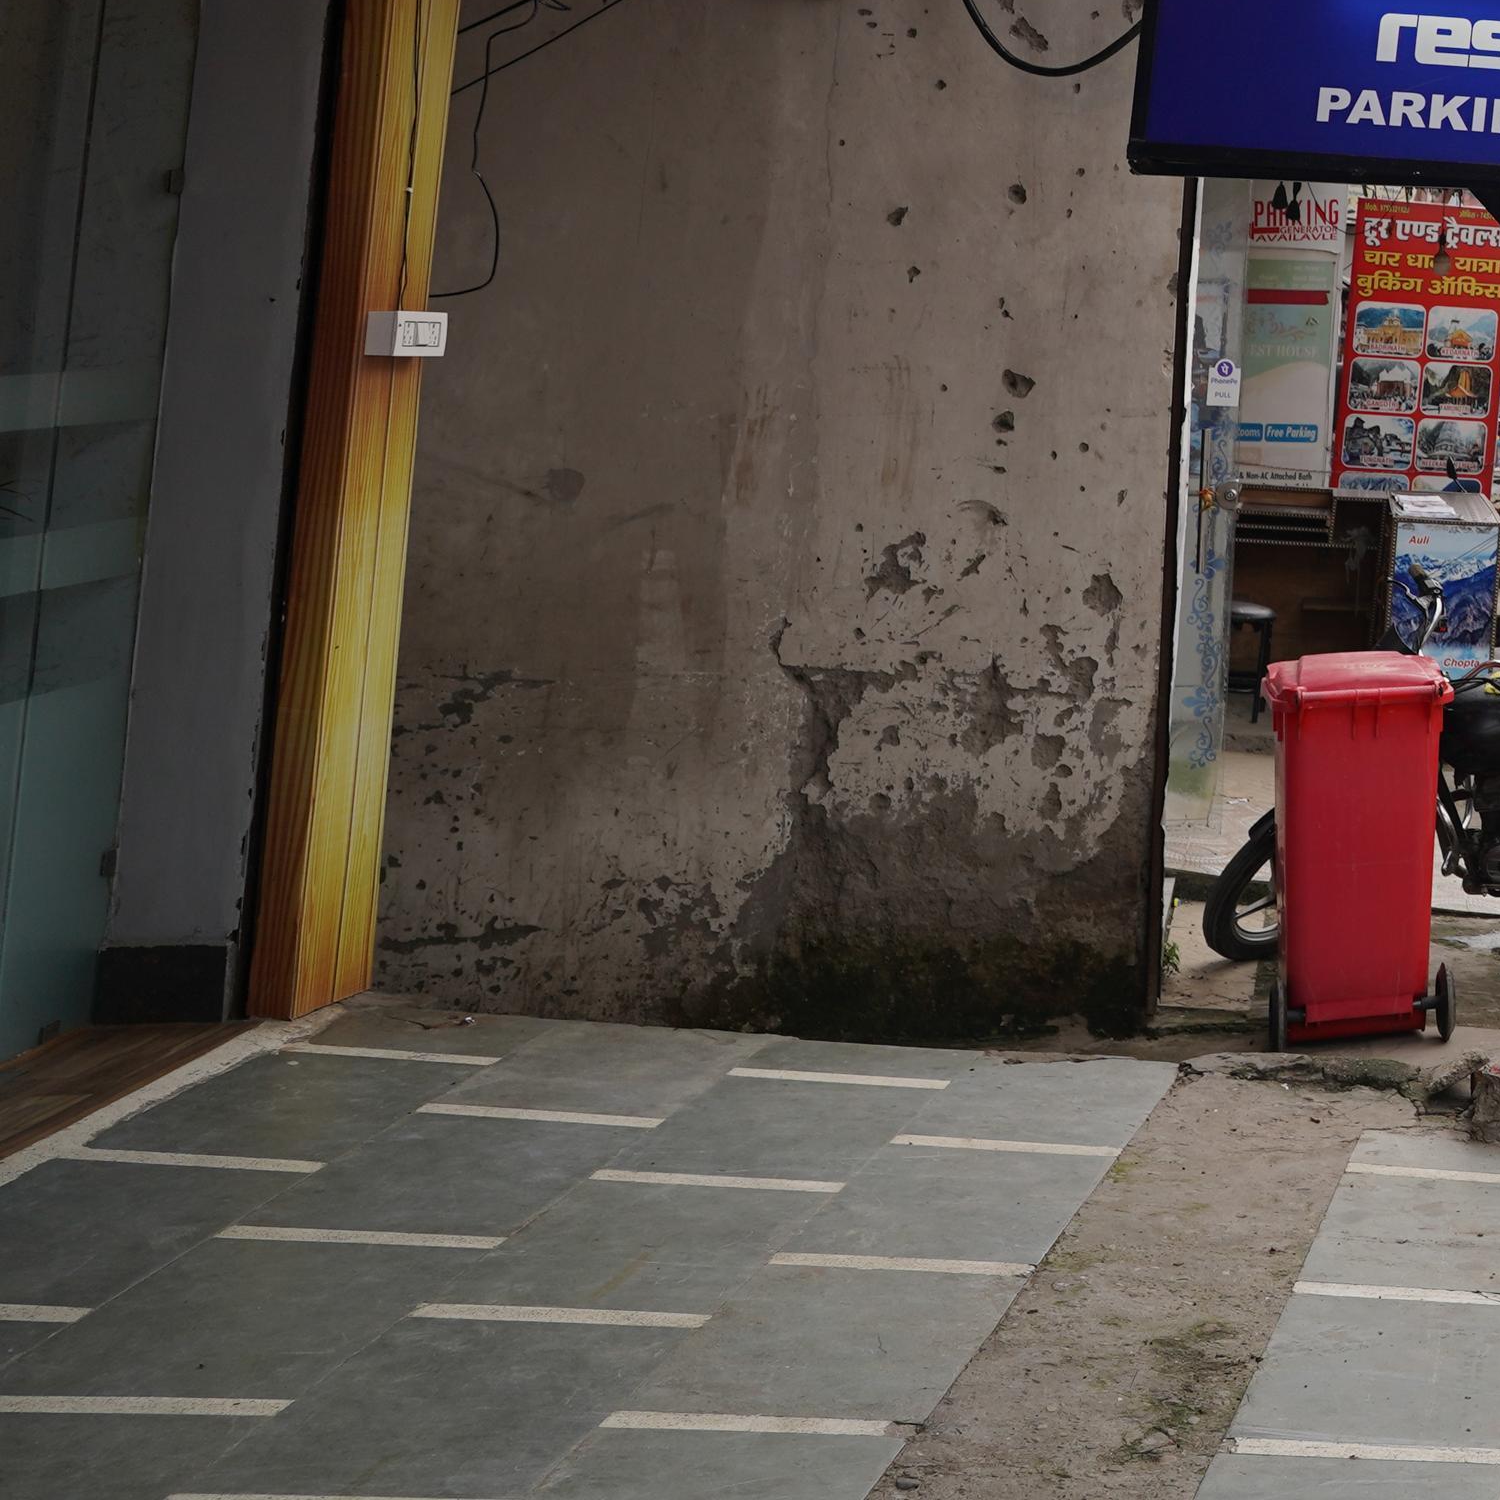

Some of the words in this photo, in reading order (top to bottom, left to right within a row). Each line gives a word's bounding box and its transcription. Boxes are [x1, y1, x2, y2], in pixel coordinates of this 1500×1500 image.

[1364, 250, 1403, 268] चार
[1407, 254, 1440, 271] धा
[1357, 270, 1425, 298] बुकिंग
[1214, 391, 1231, 399] PULL
[1238, 426, 1261, 438] ooms
[1266, 425, 1283, 438] Free
[1285, 425, 1317, 441] Parking
[1408, 535, 1430, 546] Auli
[1443, 658, 1480, 669] Chopta
